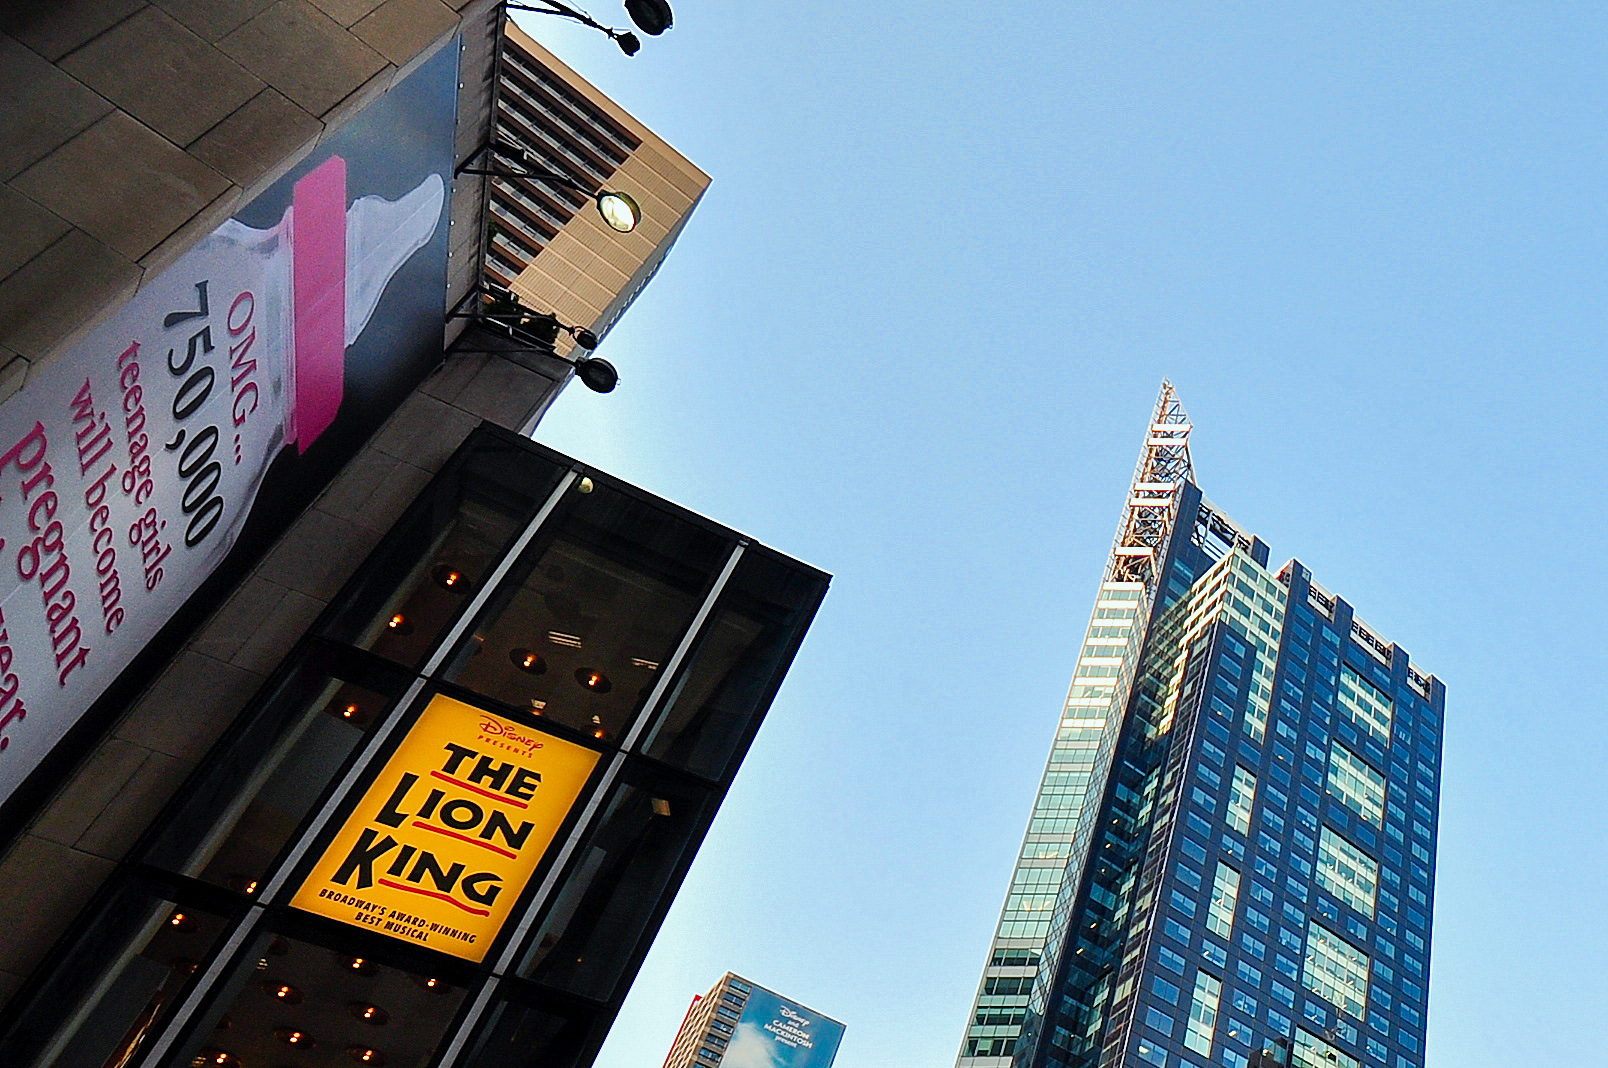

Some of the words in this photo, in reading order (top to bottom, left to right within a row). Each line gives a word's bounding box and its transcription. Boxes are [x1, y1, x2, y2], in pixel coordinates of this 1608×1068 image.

[72, 377, 113, 476] will
[117, 340, 153, 507] teenage
[163, 280, 224, 549] 750,000
[0, 421, 92, 688] pregnant
[83, 463, 126, 635] become
[129, 507, 172, 592] girls
[441, 742, 542, 802] THE
[477, 734, 534, 759] PRESENTS
[374, 771, 536, 851] LION
[329, 827, 505, 908] KING
[318, 887, 388, 917] BROADWAY'S
[387, 909, 478, 945] AWARD-WINNING
[354, 910, 384, 929] BEST
[383, 919, 430, 943] MUSICAL
[764, 1023, 813, 1049] MACKINTOSH
[772, 1019, 810, 1040] CAMERON
